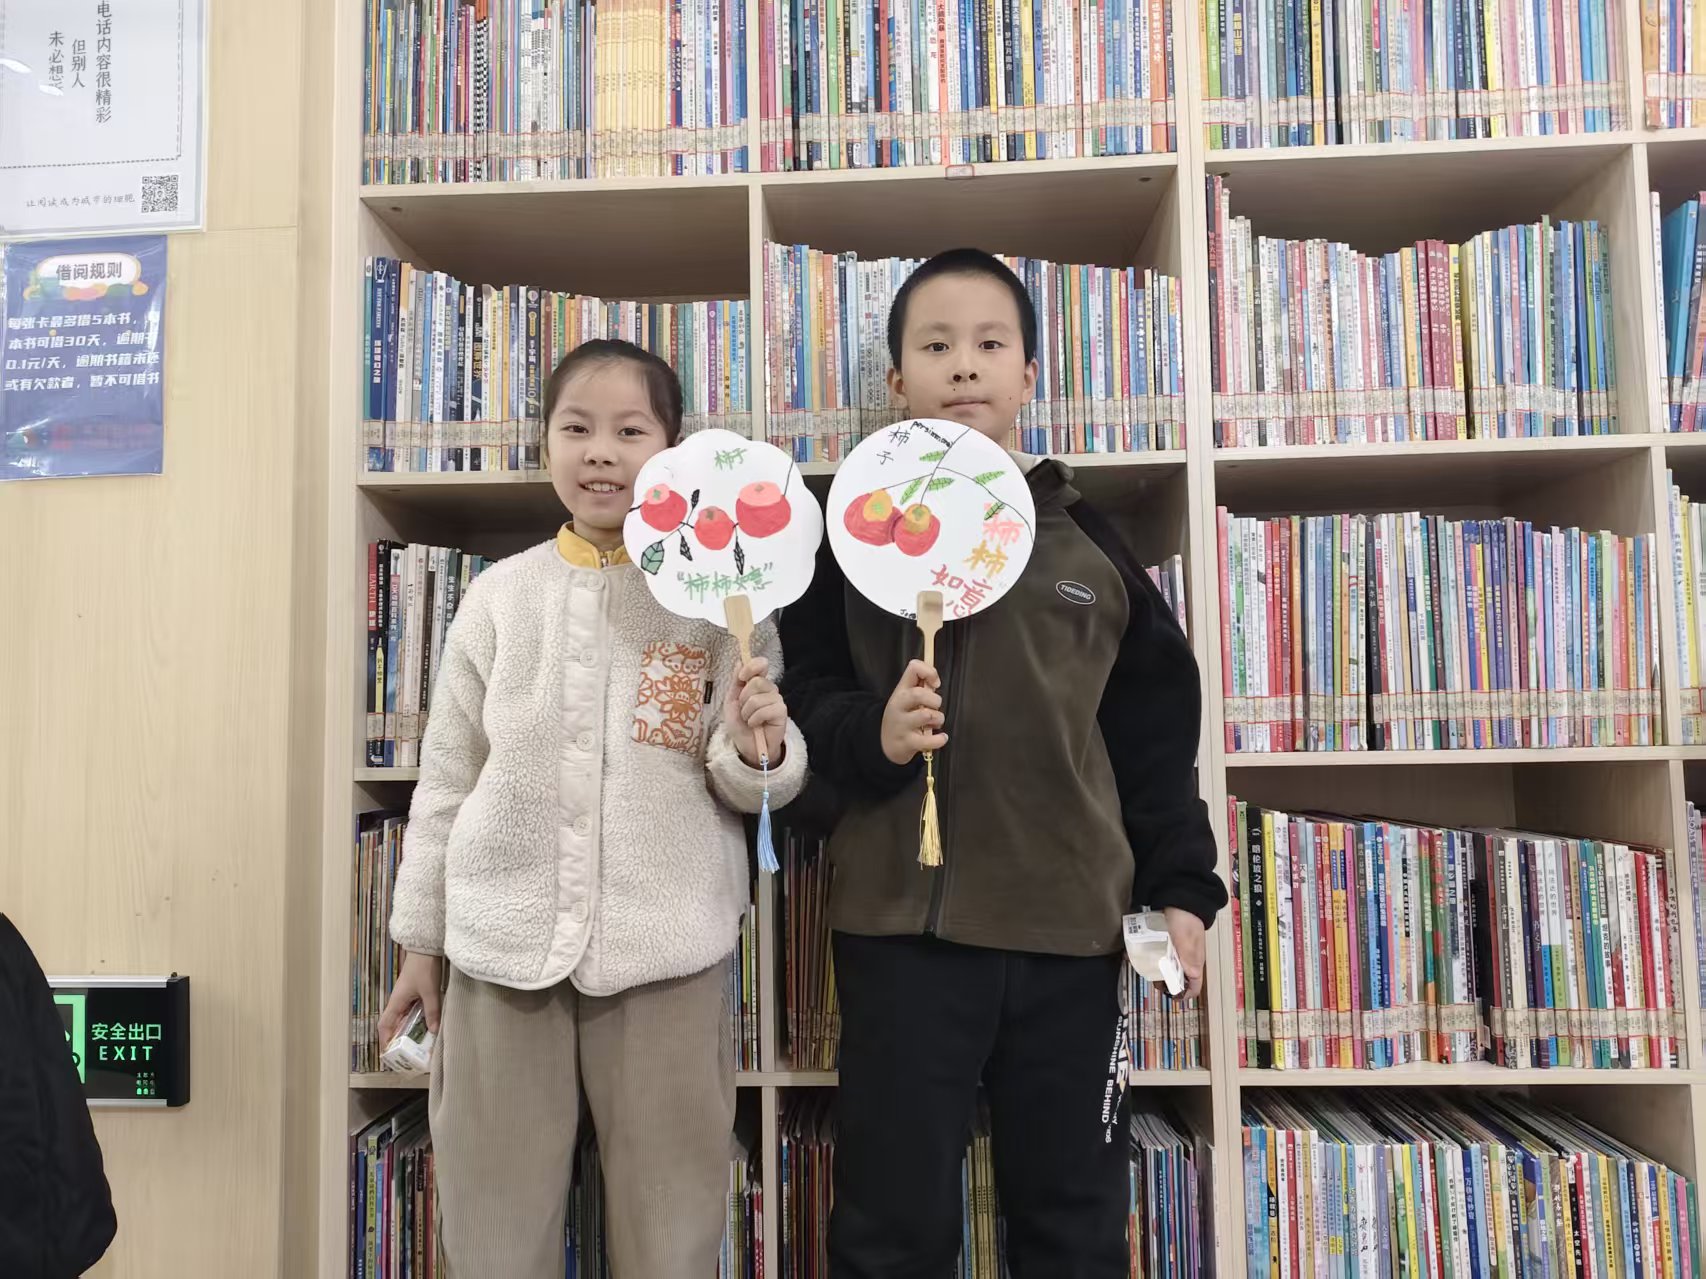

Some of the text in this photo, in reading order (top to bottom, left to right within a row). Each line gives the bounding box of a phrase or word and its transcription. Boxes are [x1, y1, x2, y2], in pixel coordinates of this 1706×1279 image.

[71, 39, 87, 88] 但别人
[96, 0, 112, 123] 电话内容很精彩
[55, 261, 123, 281] 借阅规则
[714, 447, 749, 471] 柿子
[91, 1022, 162, 1041] 安全出口
[99, 1045, 154, 1061] EXIT
[1101, 1079, 1114, 1123] BEHIND
